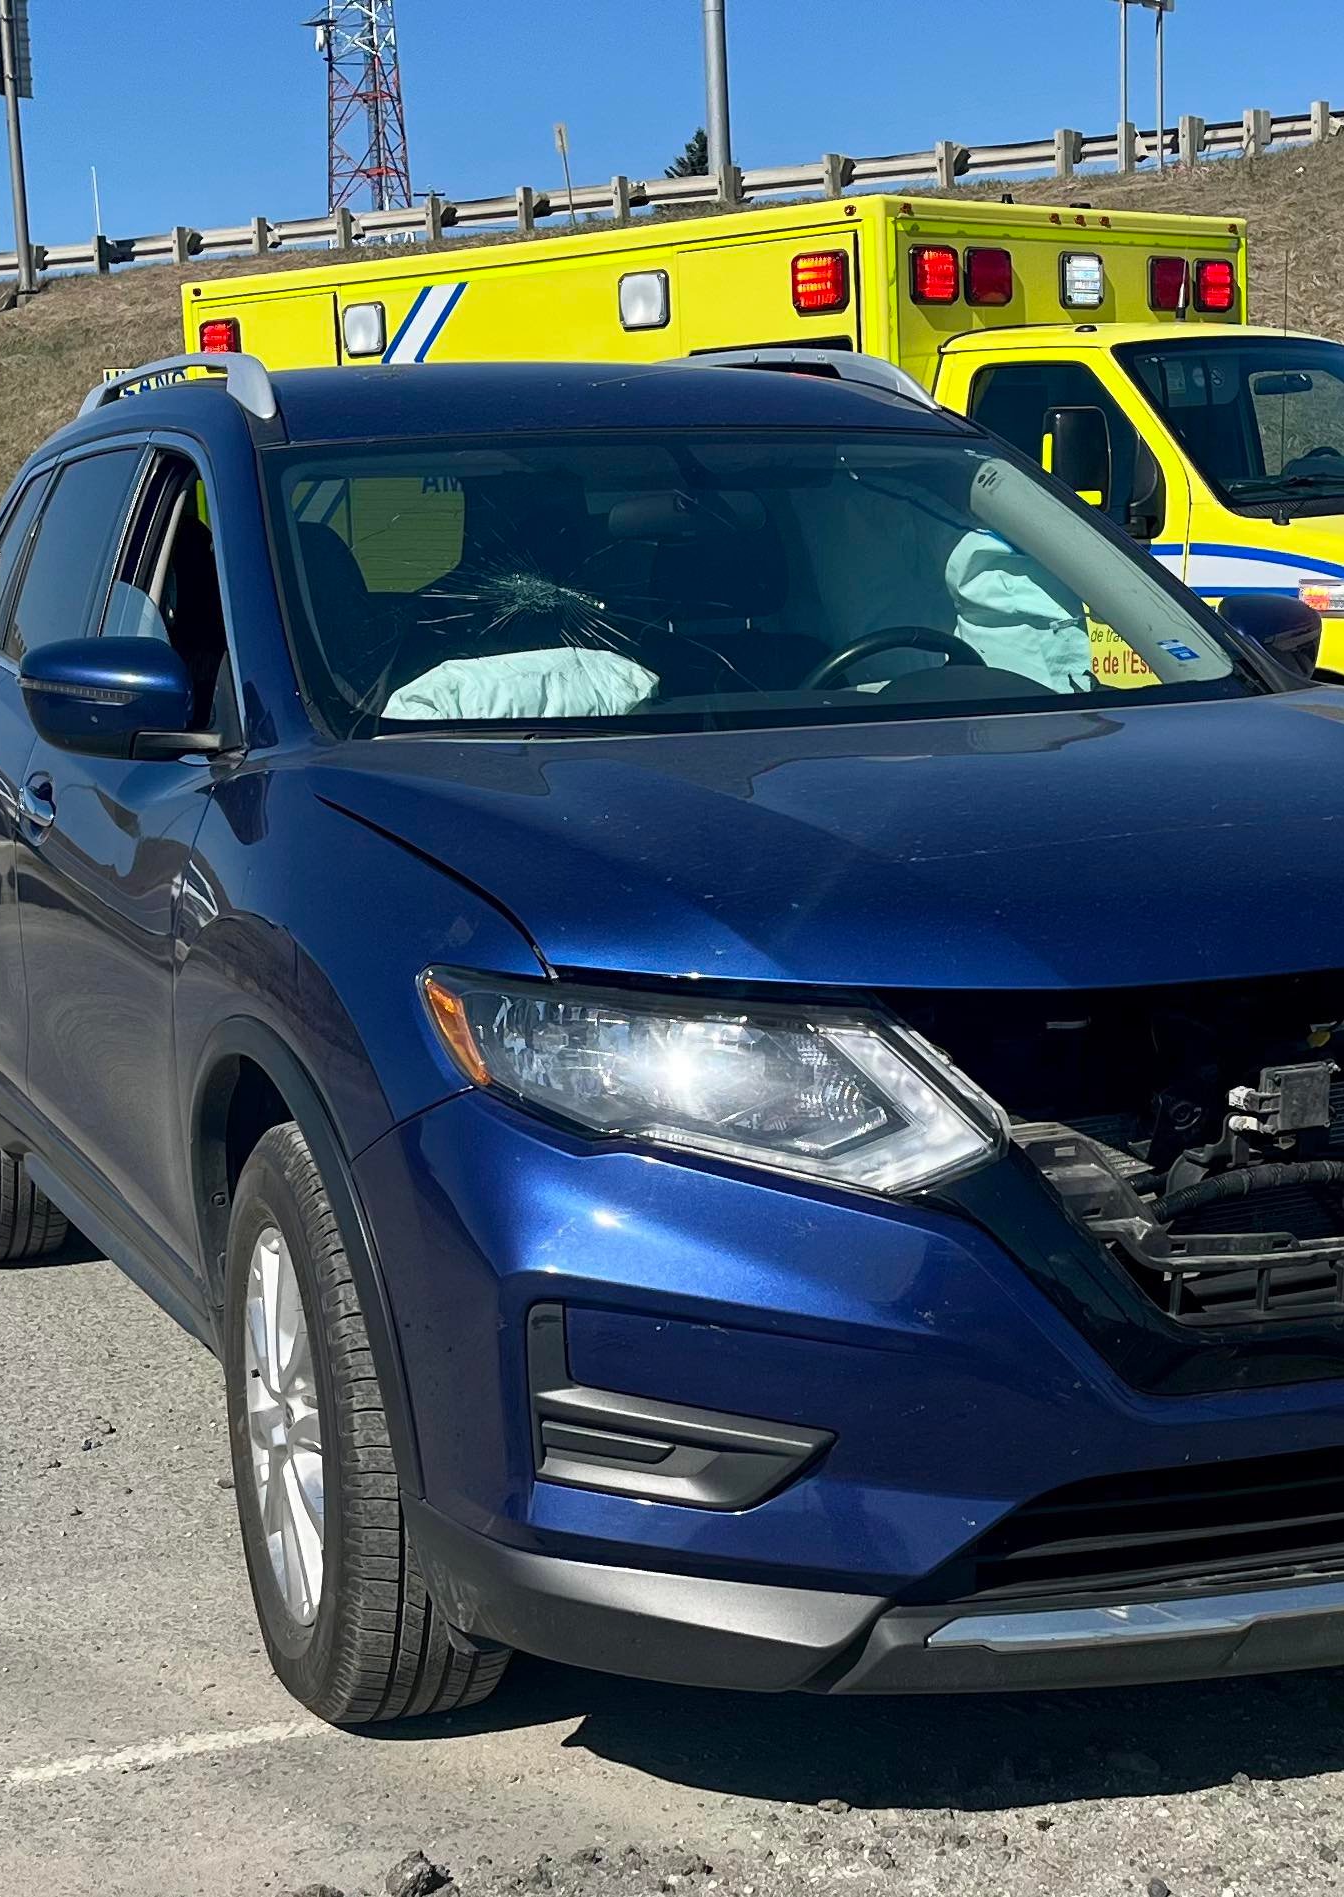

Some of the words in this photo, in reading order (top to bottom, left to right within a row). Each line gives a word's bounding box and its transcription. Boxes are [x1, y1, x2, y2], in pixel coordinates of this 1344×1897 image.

[1090, 627, 1104, 642] de
[1103, 650, 1119, 674] de
[1123, 650, 1153, 674] l'Es
